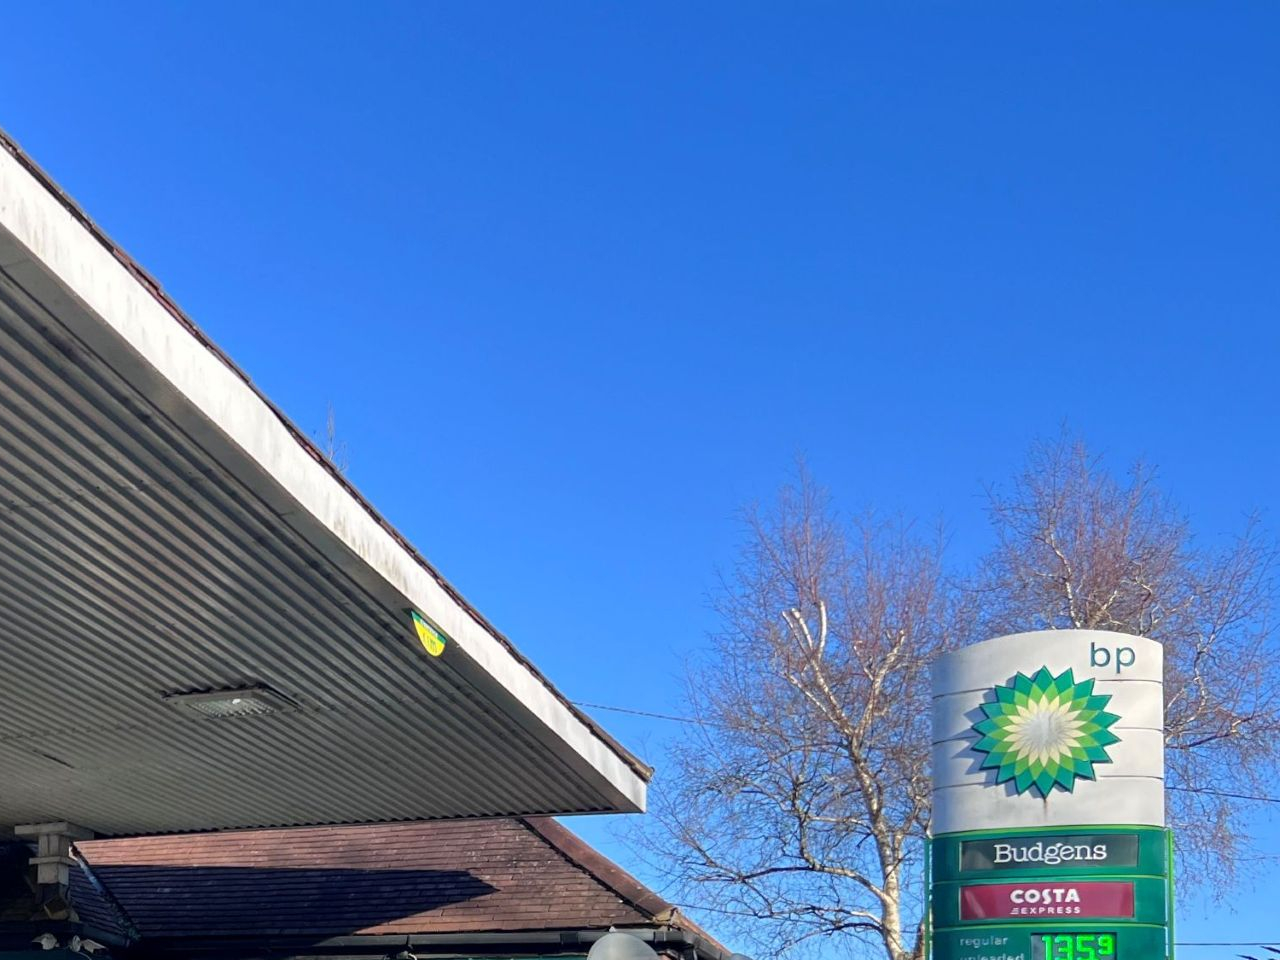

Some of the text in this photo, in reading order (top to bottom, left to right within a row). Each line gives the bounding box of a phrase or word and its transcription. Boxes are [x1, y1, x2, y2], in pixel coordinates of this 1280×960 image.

[1090, 642, 1136, 673] bp
[993, 842, 1108, 865] Budgens
[1010, 888, 1081, 905] COSTA
[1020, 906, 1081, 915] EXPRESS
[960, 937, 1009, 949] regular
